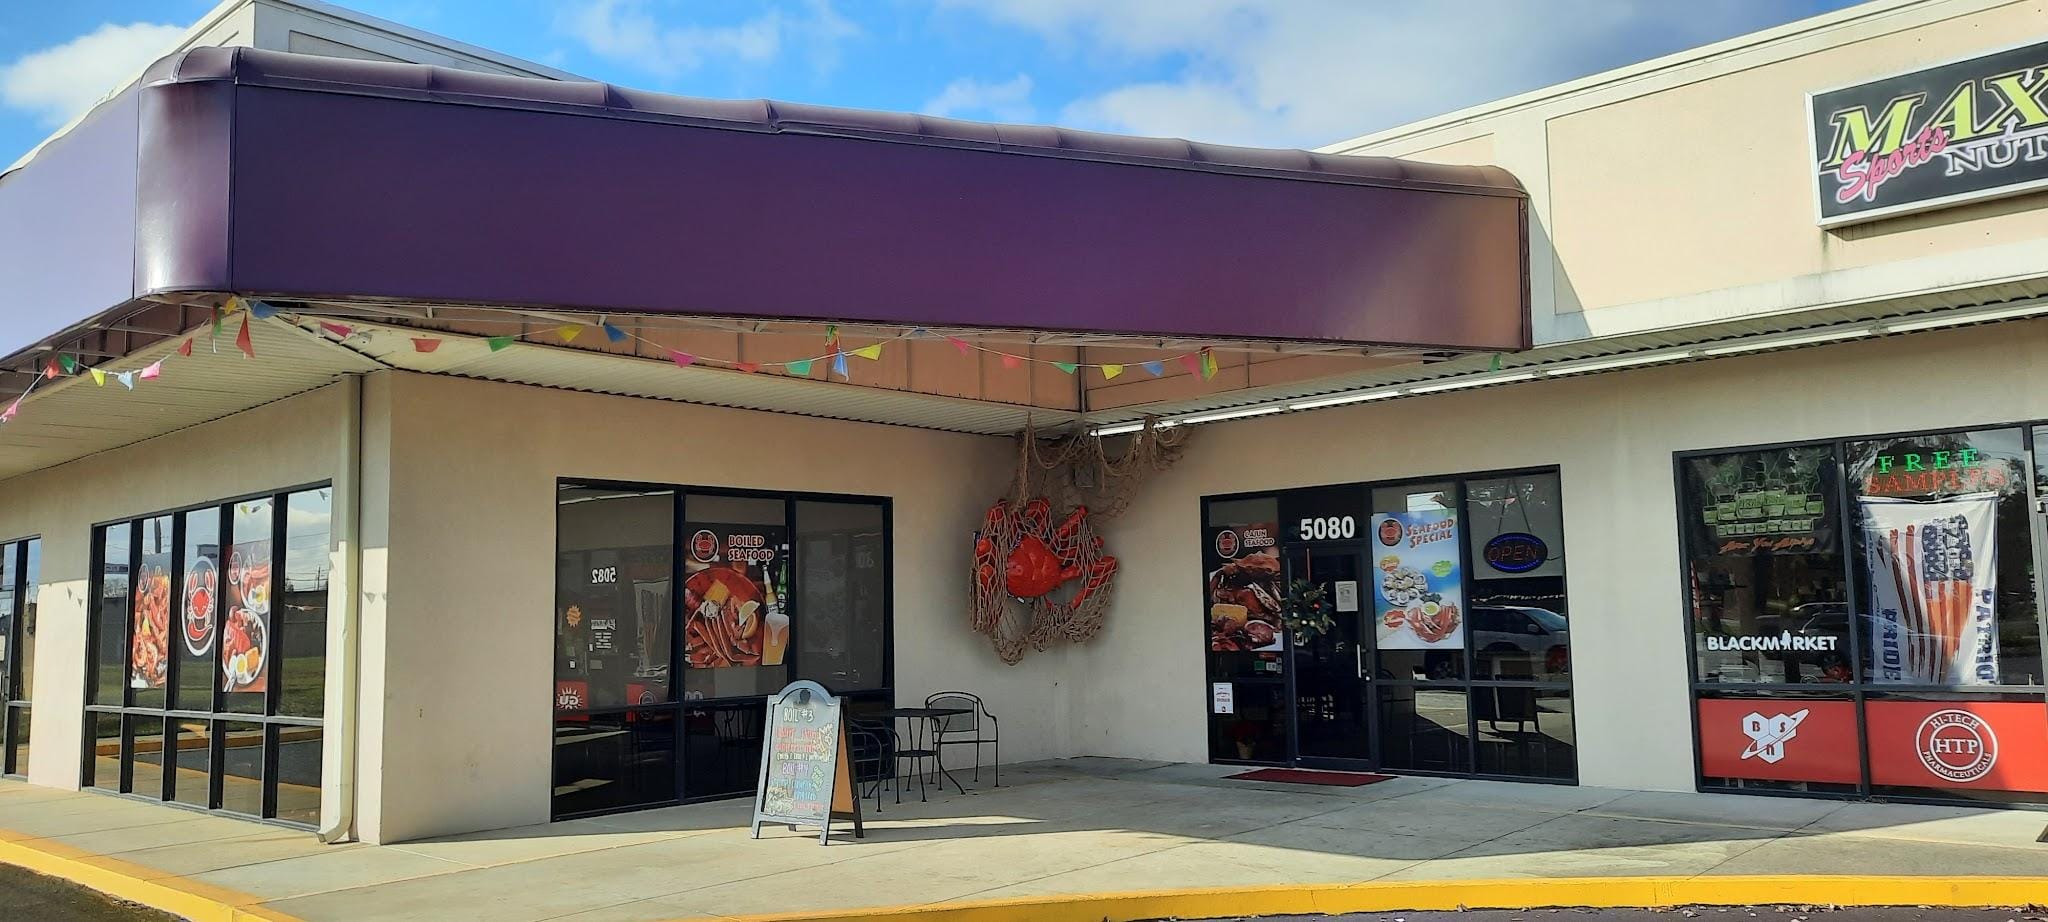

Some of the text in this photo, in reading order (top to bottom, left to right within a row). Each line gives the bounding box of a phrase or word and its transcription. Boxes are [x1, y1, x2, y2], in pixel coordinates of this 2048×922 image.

[1836, 126, 1948, 203] Sports
[1878, 448, 1980, 474] FREE
[1866, 468, 2007, 494] SAMPLES
[1244, 529, 1267, 539] CAJUN
[1300, 515, 1355, 540] 5080
[1406, 518, 1455, 536] SEAFOOD
[727, 535, 765, 548] BOILED
[1244, 538, 1275, 547] SEAFOOD
[1410, 531, 1453, 549] SPECIAL
[727, 547, 775, 562] SEAFOOD
[1487, 543, 1540, 562] OPEN
[1881, 608, 1902, 681] PRIDE
[1975, 589, 1997, 683] PATRIO
[783, 708, 815, 722] BOIL #3
[1929, 714, 1981, 730] HI-TECH
[1934, 738, 1978, 754] HTP
[1922, 751, 1993, 778] PHARMACEUTICALS
